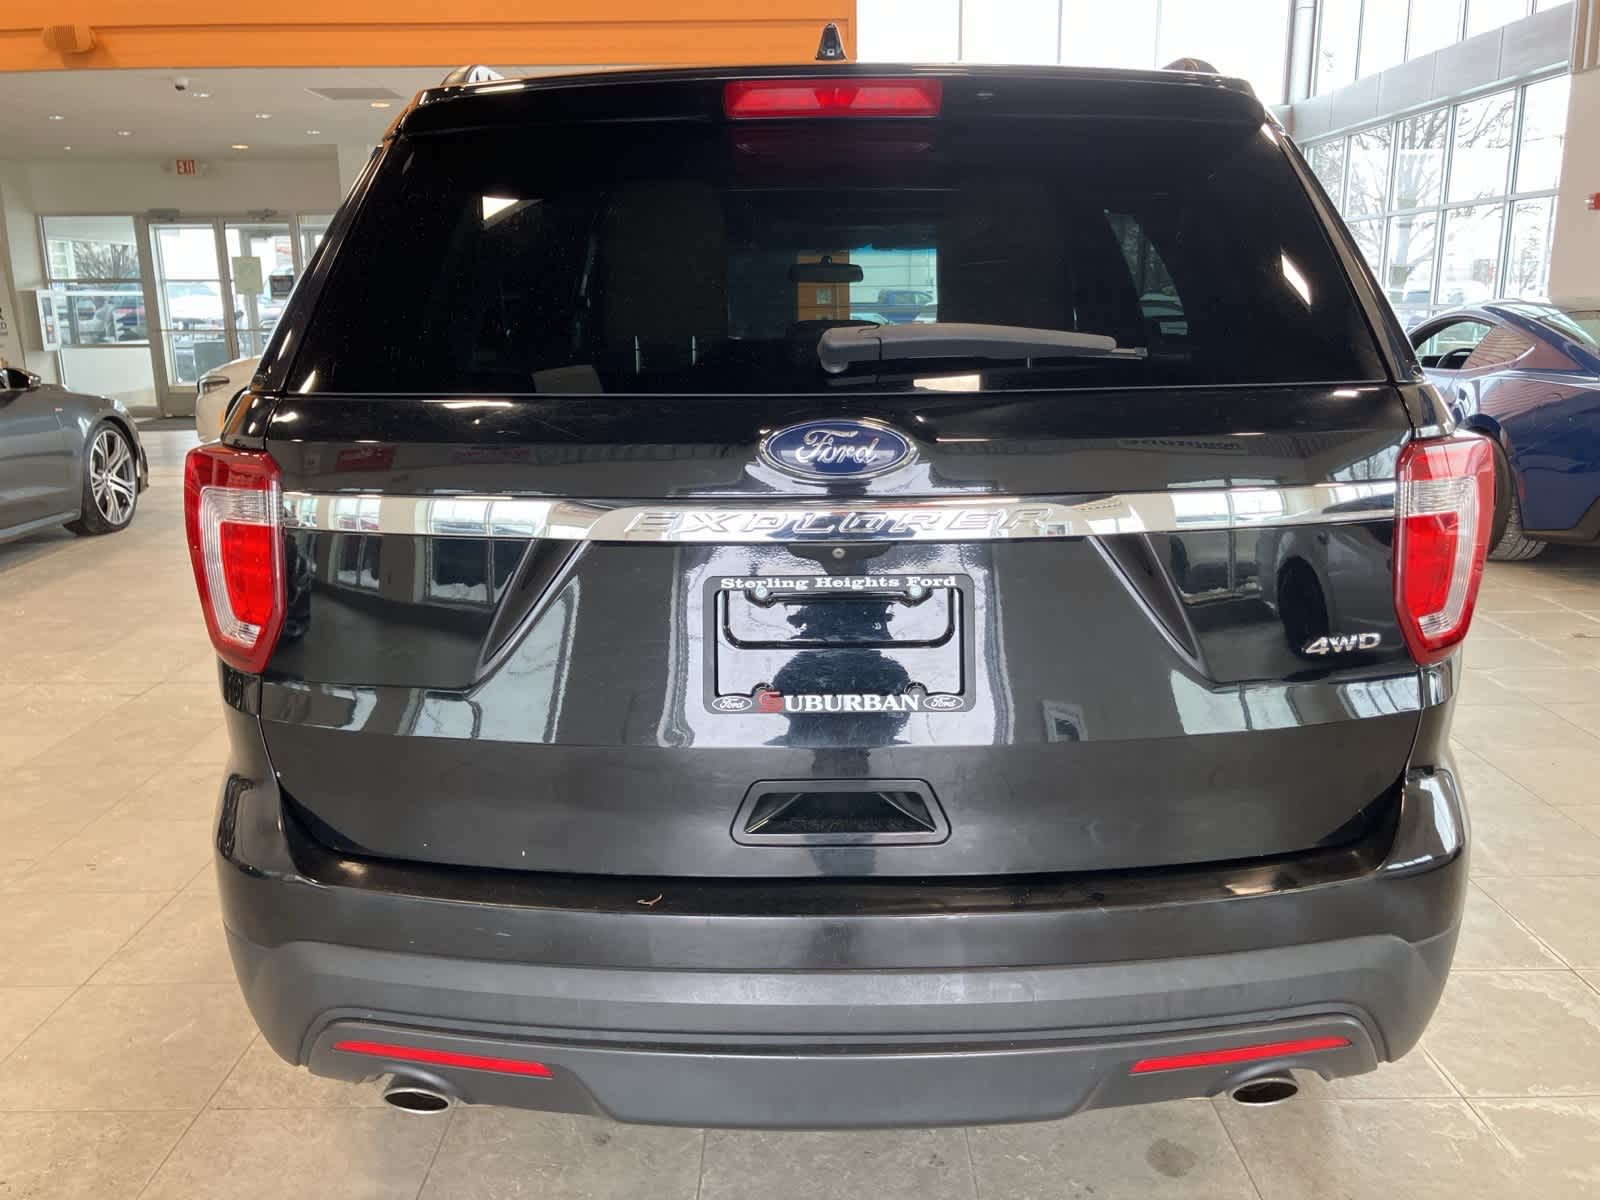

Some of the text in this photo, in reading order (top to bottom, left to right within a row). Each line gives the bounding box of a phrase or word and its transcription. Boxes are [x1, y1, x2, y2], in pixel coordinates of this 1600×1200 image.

[176, 158, 197, 176] EXIT
[795, 429, 880, 464] Ford
[623, 506, 1056, 535] EXPLORER
[720, 576, 957, 590] Sterling Heights Ford
[1304, 632, 1382, 655] 4WD
[719, 698, 746, 709] Ford
[758, 689, 920, 714] SUBURBAN
[930, 697, 956, 708] Ford
